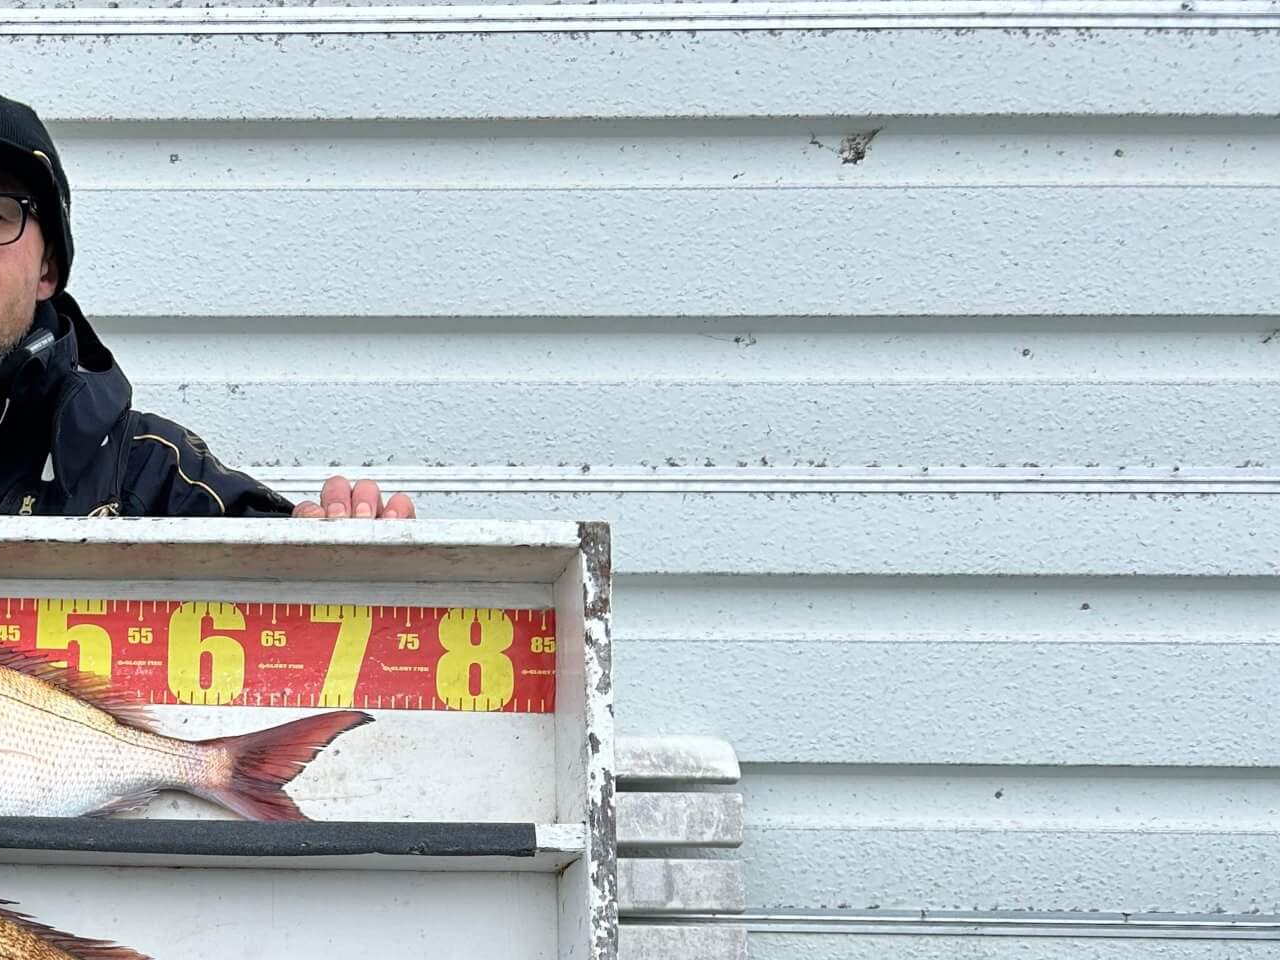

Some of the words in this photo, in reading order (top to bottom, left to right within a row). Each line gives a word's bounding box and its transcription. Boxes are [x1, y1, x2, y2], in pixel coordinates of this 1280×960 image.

[128, 627, 153, 644] 55
[168, 601, 246, 705] 6
[261, 630, 287, 647] 65
[311, 605, 373, 708] 7
[397, 634, 420, 650] 75
[436, 608, 514, 711] 8
[531, 636, 556, 653] 85
